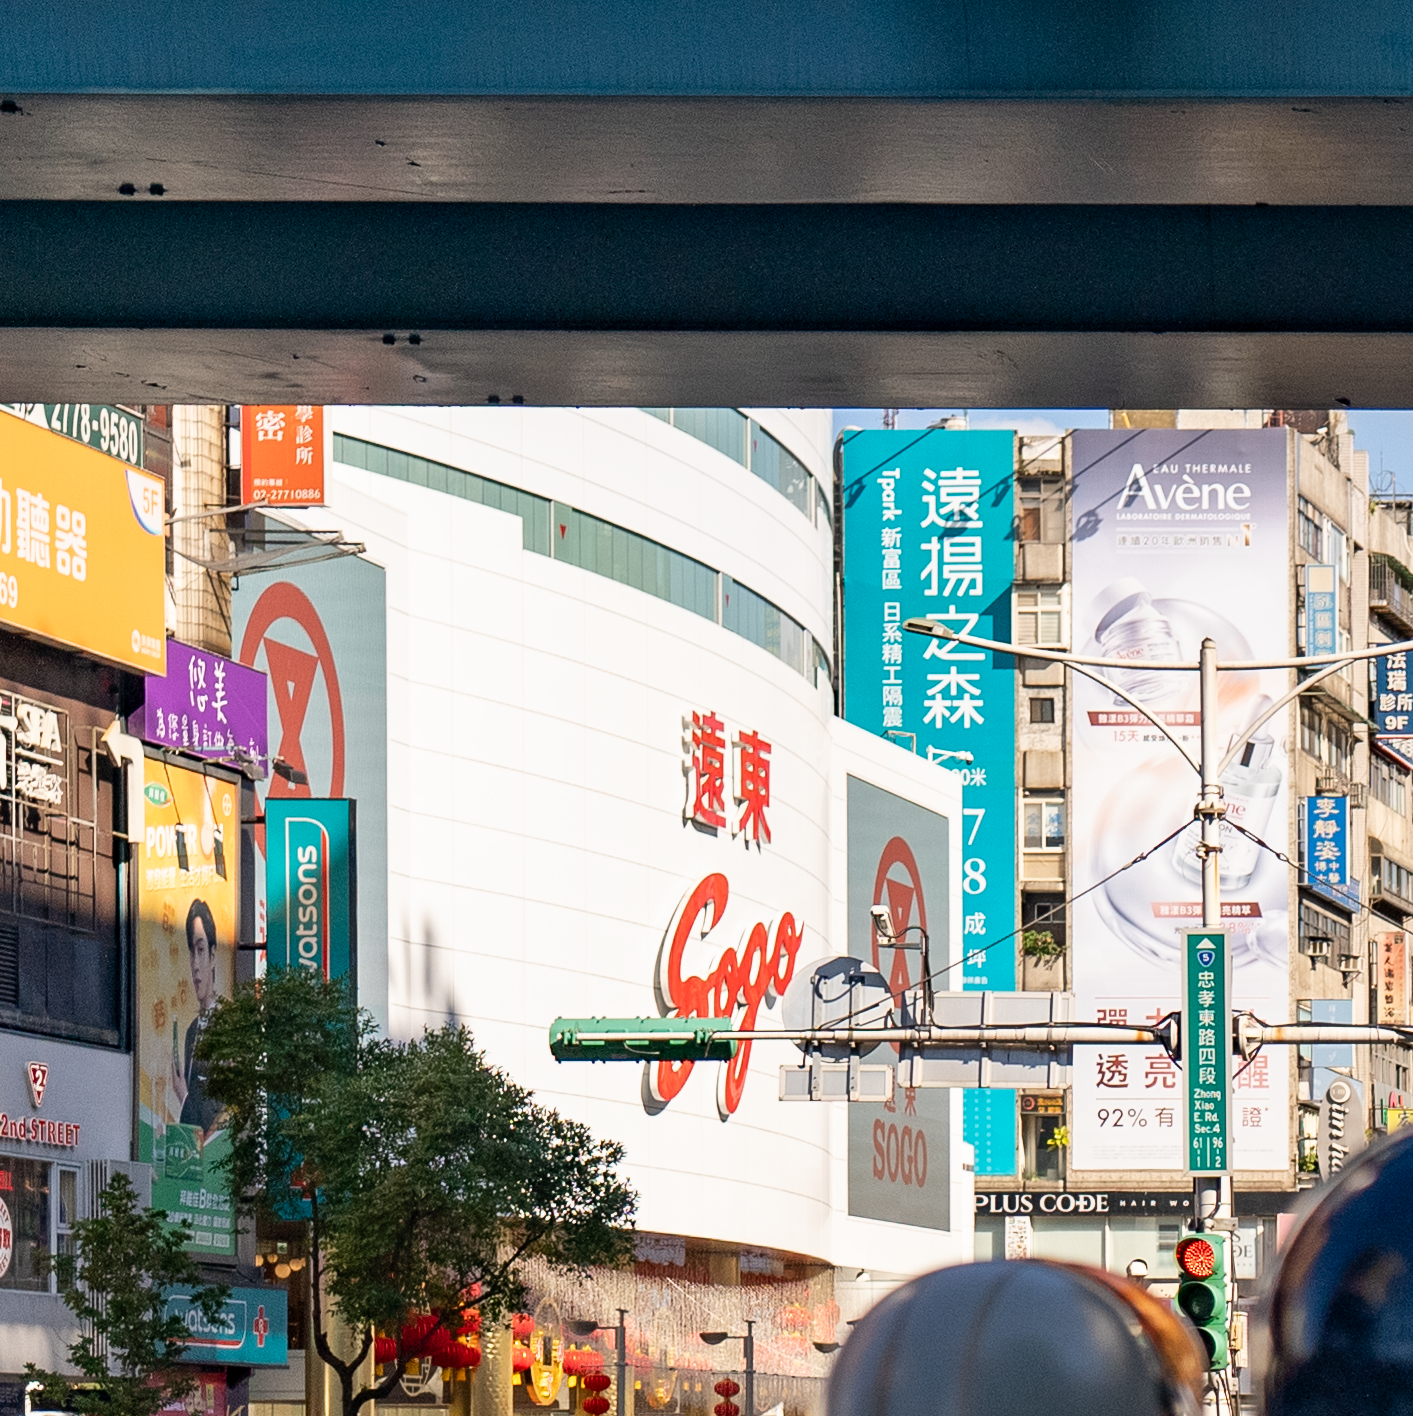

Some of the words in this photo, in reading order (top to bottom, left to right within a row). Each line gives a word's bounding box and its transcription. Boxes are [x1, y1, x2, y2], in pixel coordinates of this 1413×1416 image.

[1153, 463, 1179, 474] EAU
[1184, 463, 1251, 474] THERMALE
[143, 486, 158, 516] 5F
[878, 468, 902, 521] Tpark
[1116, 463, 1251, 510] Avène
[881, 527, 902, 590] 新富區
[920, 466, 985, 729] 遠揚之森
[881, 602, 903, 727] 日系精工隔震
[1380, 693, 1413, 712] 診所
[1385, 716, 1409, 730] 9F
[686, 709, 772, 844] 遠東
[952, 767, 987, 787] 0米
[146, 826, 198, 858] POWR
[963, 857, 987, 896] 8
[1202, 953, 1210, 962] 5
[650, 872, 804, 1115] Sogo
[1198, 971, 1217, 1084] 忠孝東路四段
[1096, 1053, 1270, 1089] 透亮醒
[1194, 1089, 1221, 1101] Zhong
[1194, 1101, 1215, 1110] Xiao
[0, 1114, 27, 1139] 2nd
[30, 1117, 80, 1146] STREET
[1097, 1108, 1148, 1128] 92%
[872, 1118, 928, 1189] SOGO
[1193, 1138, 1203, 1149] 61
[1212, 1137, 1223, 1149] 96
[1215, 1156, 1221, 1168] 2
[974, 1194, 1035, 1213] PLUS
[1119, 1199, 1157, 1207] HAIR
